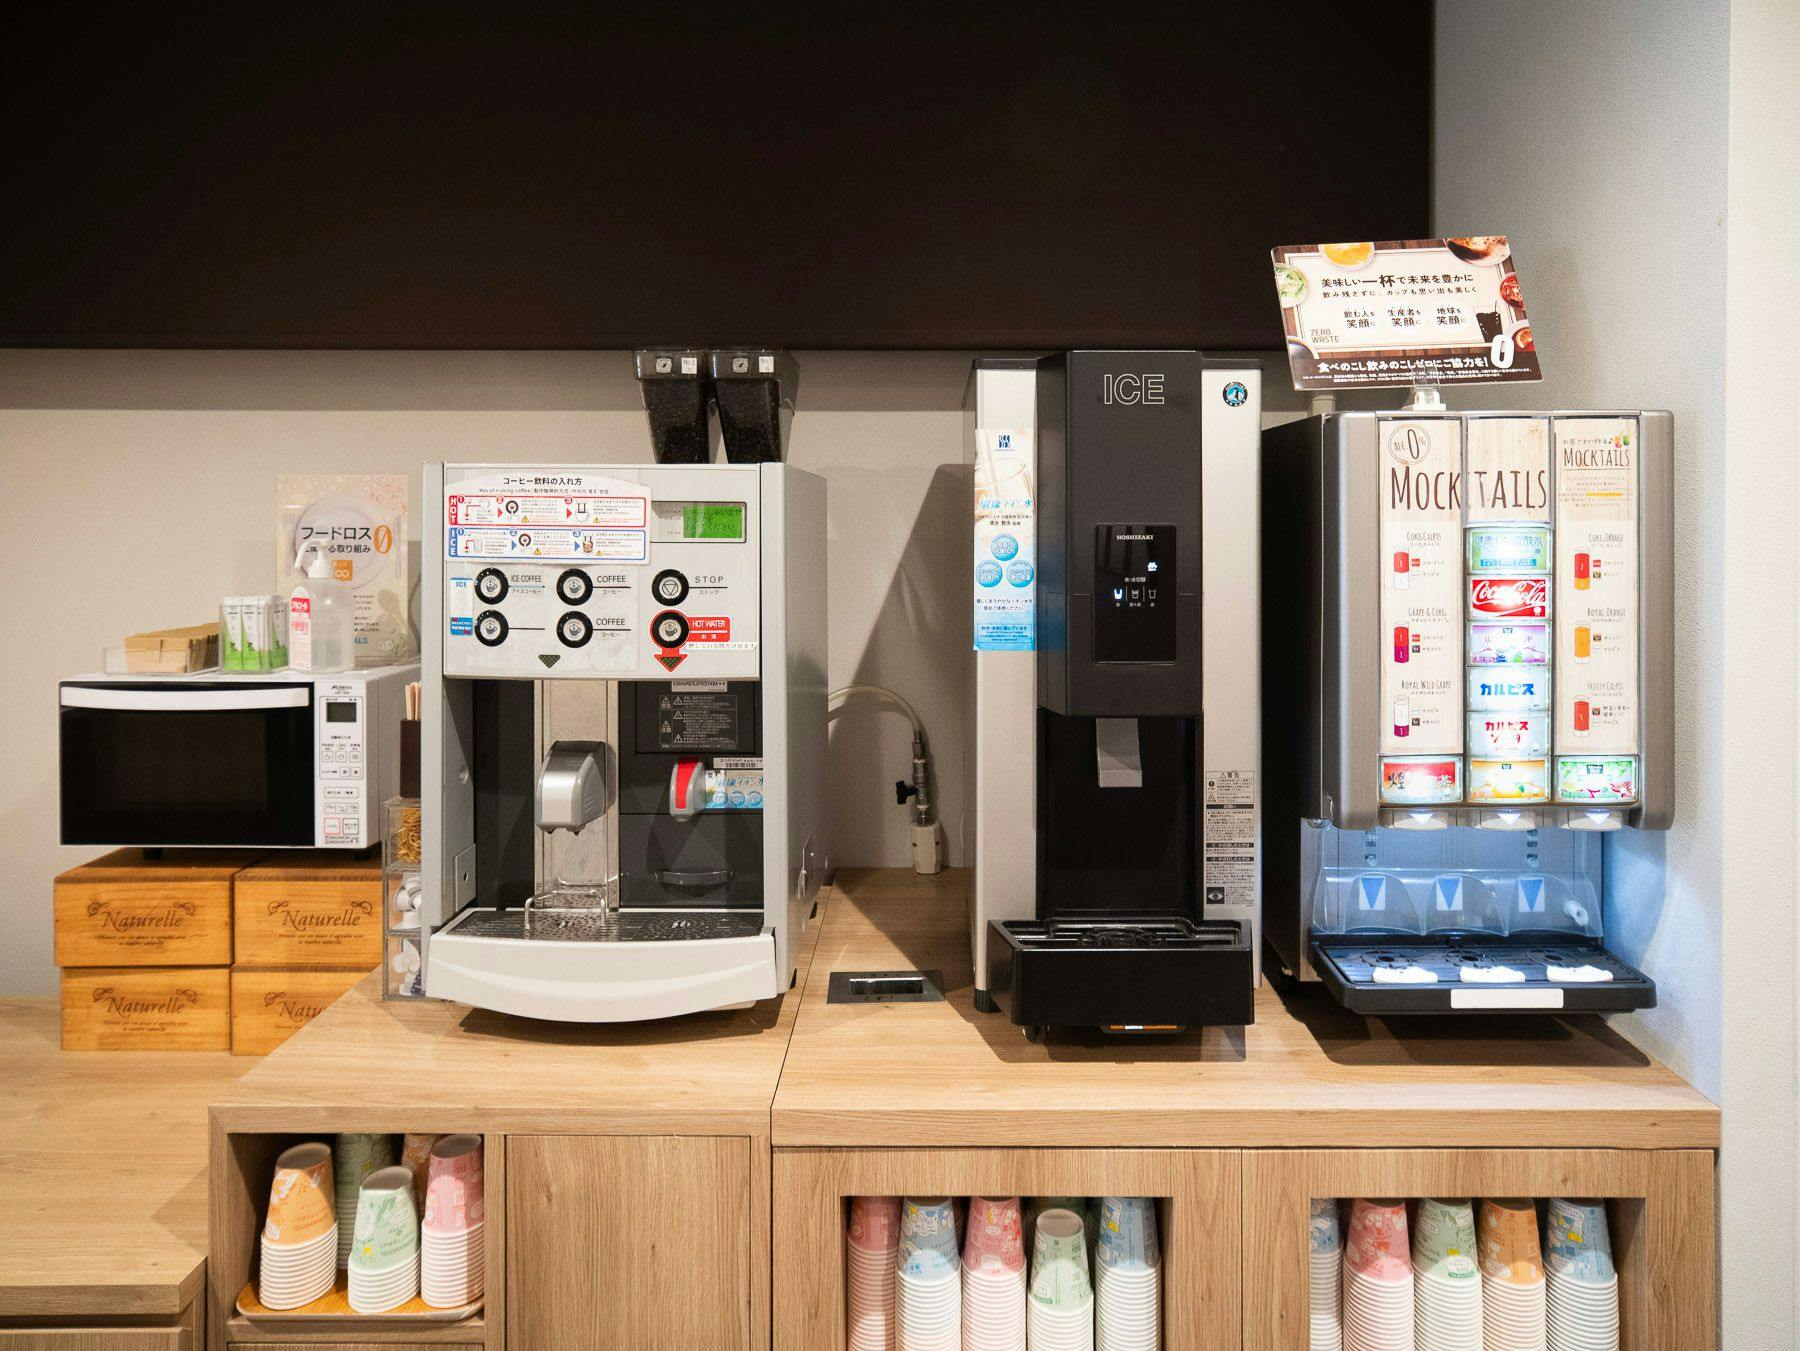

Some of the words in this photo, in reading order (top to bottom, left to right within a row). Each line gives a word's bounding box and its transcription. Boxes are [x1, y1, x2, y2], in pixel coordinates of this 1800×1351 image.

[1321, 273, 1474, 288] 美味しい一杯で未来を豊かに
[1346, 318, 1376, 329] 笑顔に
[1391, 317, 1421, 327] 笑顔に
[1436, 316, 1466, 326] 笑顔に
[1310, 328, 1331, 337] ZERO
[1312, 336, 1340, 344] WASTE
[1103, 373, 1165, 405] ICE
[1563, 448, 1630, 467] MOCKTAILS
[503, 477, 582, 487] コーヒー飲料の入れ方
[449, 497, 458, 525] HOT
[301, 526, 372, 541] フードロス
[449, 528, 457, 556] ICE
[511, 575, 520, 583] ICE
[521, 574, 542, 583] COFFEE
[597, 574, 627, 583] COFFEE
[694, 575, 724, 583] STOP
[1587, 607, 1605, 617] ROYAL
[1605, 607, 1626, 617] ORANGE
[596, 617, 626, 626] COFFEE
[692, 620, 704, 628] HOT
[704, 620, 726, 628] WATER
[1401, 680, 1419, 690] ROYAL
[1420, 680, 1435, 690] WILD
[1435, 680, 1452, 690] GRAPE
[1480, 683, 1536, 696] カルピス
[101, 911, 184, 934] Naturelle
[281, 909, 361, 932] Naturelle
[106, 996, 186, 1019] Naturelle
